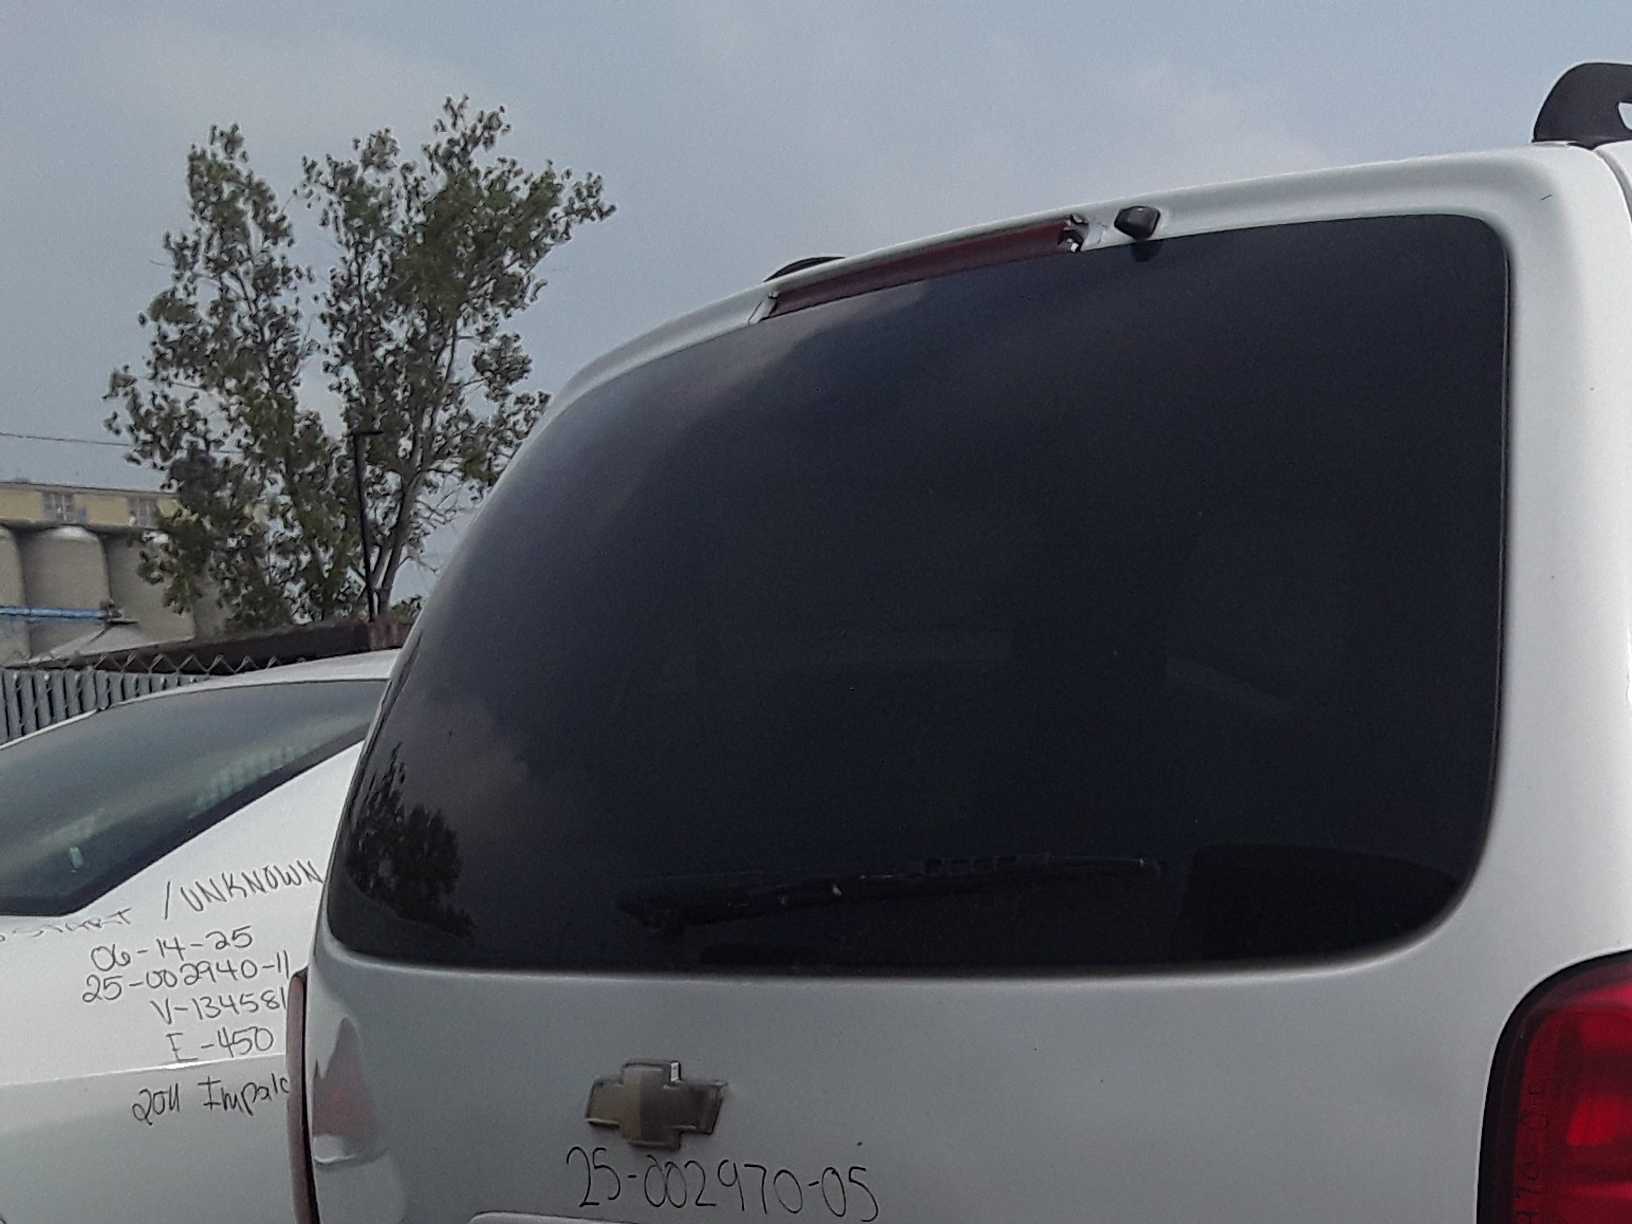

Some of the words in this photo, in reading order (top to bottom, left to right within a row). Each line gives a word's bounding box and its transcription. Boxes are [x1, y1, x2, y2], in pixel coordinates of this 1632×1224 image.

[90, 925, 252, 971] 06-14-25
[82, 950, 290, 1003] 25-002940-11
[150, 986, 287, 1025] V-134581
[566, 1145, 880, 1222] 25-002970-05
